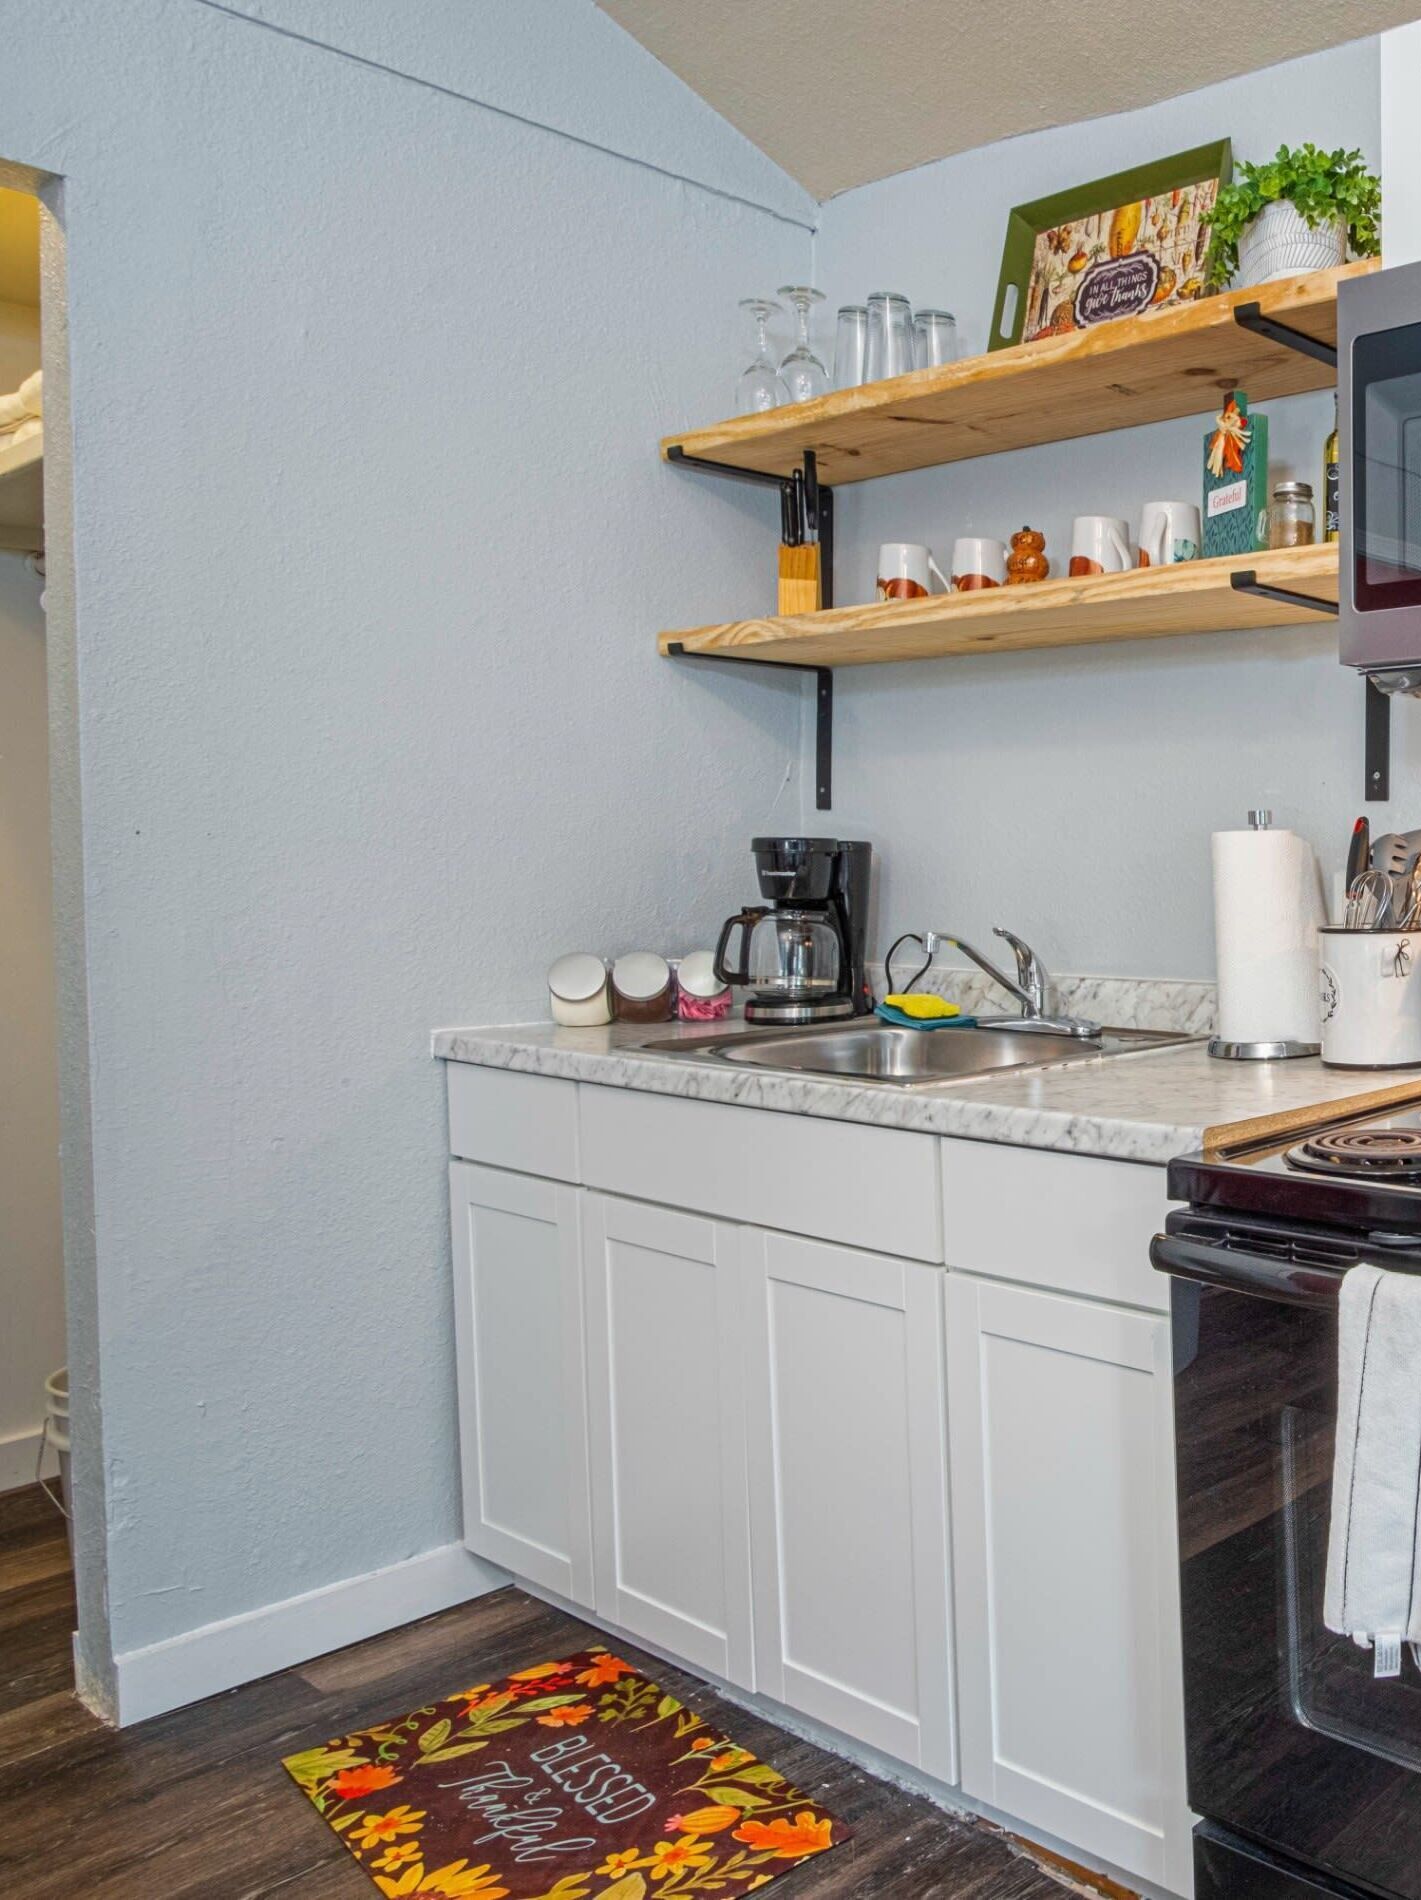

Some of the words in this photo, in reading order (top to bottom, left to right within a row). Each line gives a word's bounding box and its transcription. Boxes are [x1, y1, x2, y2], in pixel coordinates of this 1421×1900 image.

[1089, 284, 1099, 295] IN
[1101, 280, 1115, 291] ALL
[1117, 271, 1149, 287] THINGS
[1084, 292, 1108, 316] give
[1110, 282, 1148, 307] thanks
[1212, 486, 1242, 508] Grateful
[530, 1735, 656, 1824] BLESSED
[523, 1787, 552, 1805] &
[437, 1760, 597, 1863] Thankful
